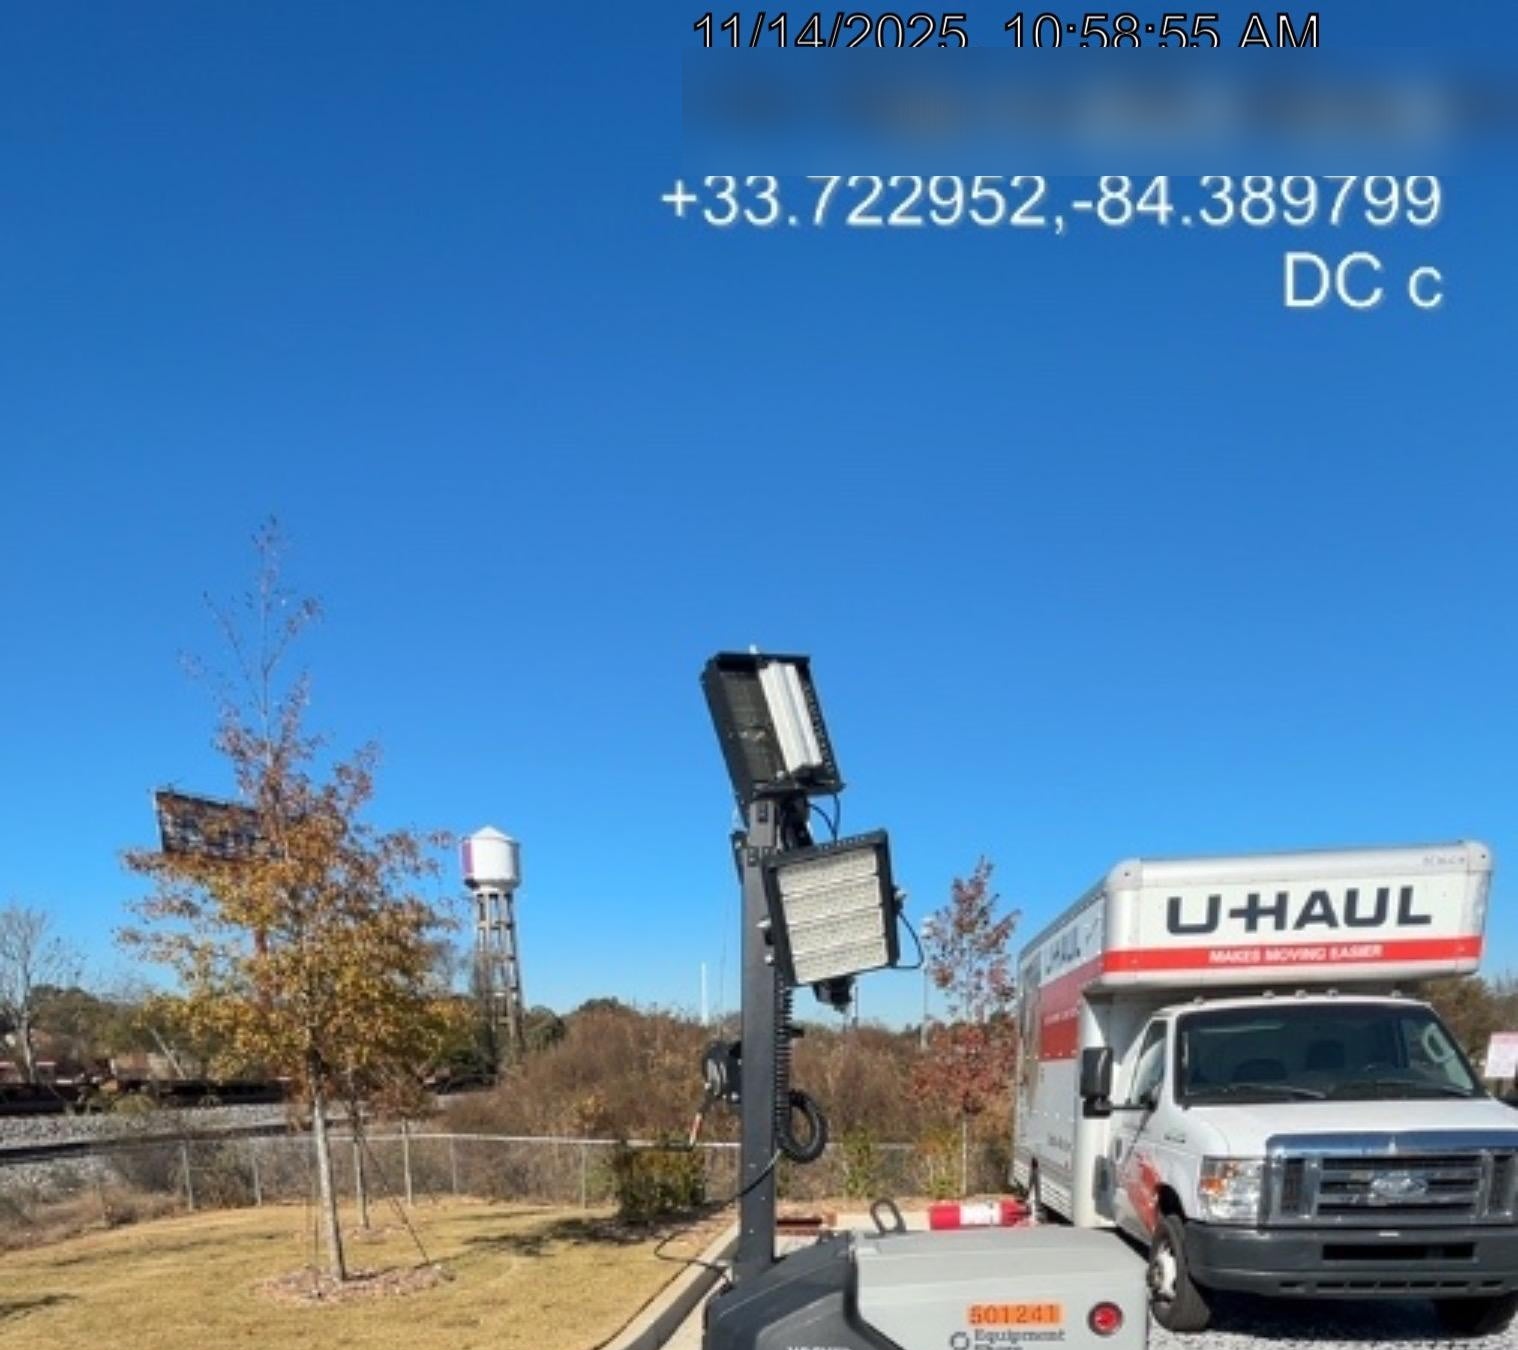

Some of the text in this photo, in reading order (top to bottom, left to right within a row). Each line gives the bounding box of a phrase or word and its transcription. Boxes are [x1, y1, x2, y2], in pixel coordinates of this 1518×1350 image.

[1166, 885, 1432, 935] U-HAUL
[1208, 943, 1384, 964] MAKES MOVING EASIER
[974, 1328, 1065, 1344] Equipment
